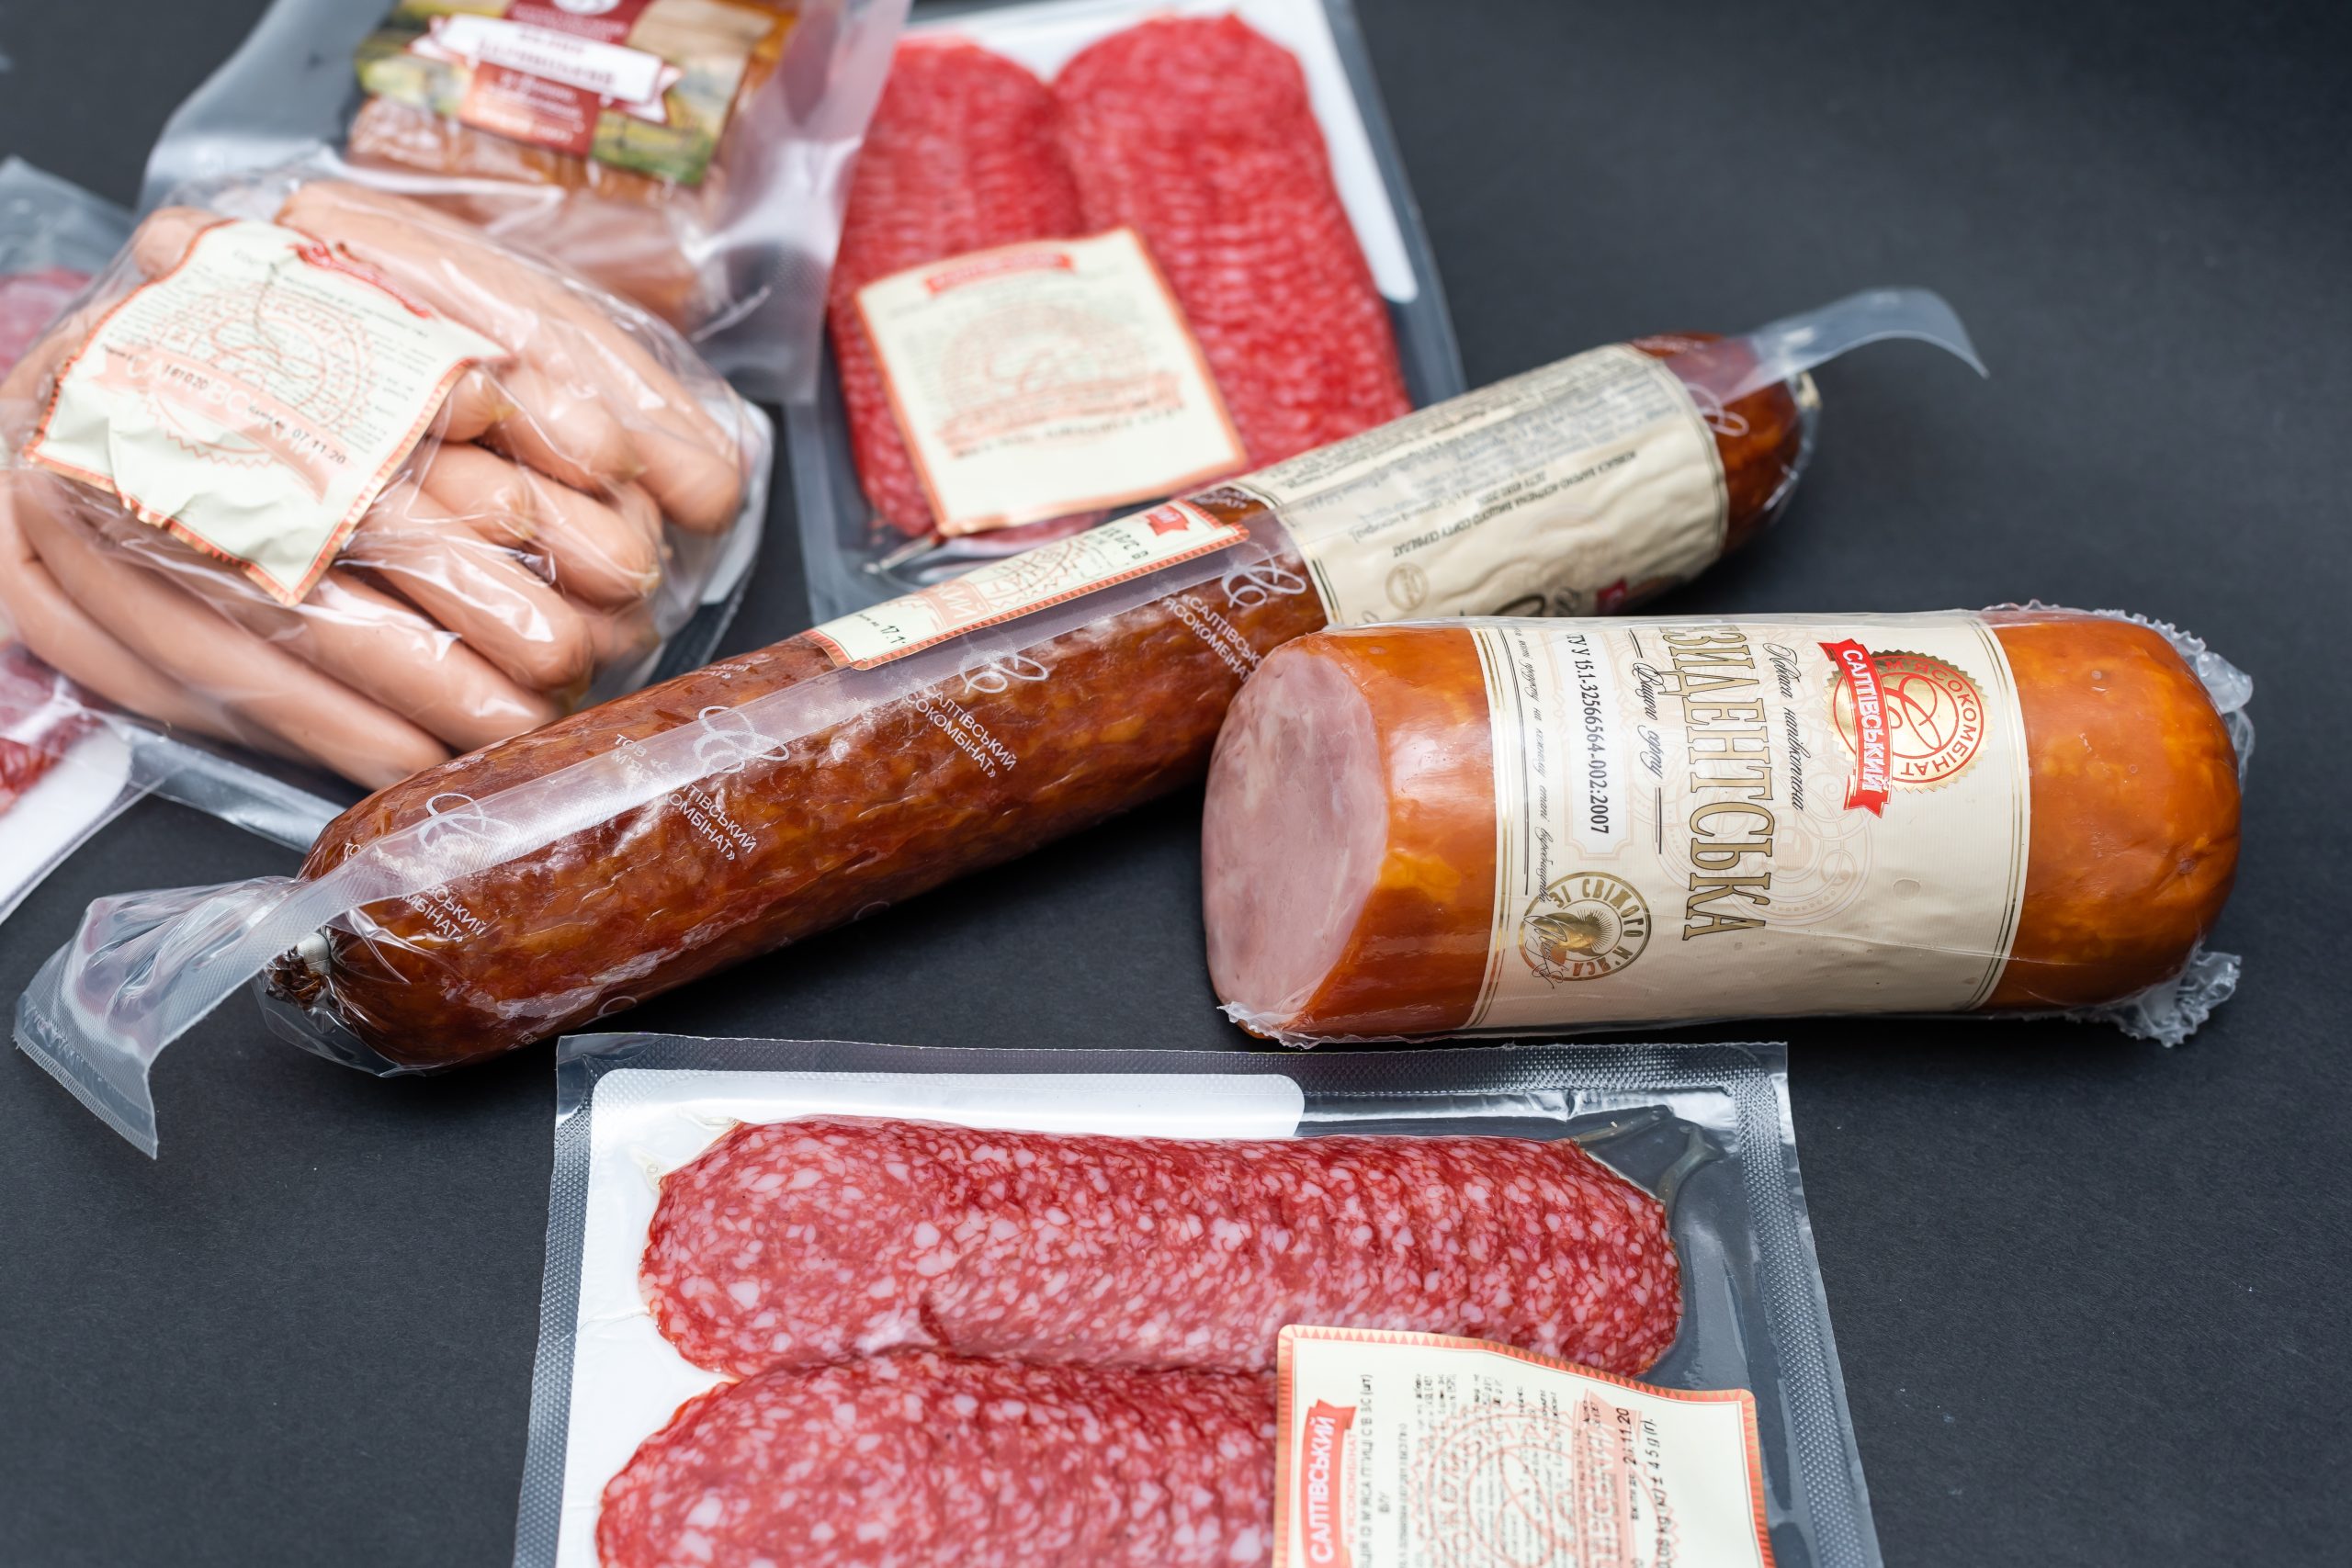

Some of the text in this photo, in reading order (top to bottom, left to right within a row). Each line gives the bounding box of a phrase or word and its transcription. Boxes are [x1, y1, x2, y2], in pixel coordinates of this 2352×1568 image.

[1571, 649, 1590, 657] У
[1533, 706, 1543, 721] на
[1574, 659, 1610, 834] 15.1-32566564-002:2007
[1632, 662, 1667, 780] Вищого сорту
[1762, 642, 1811, 812] Ковбаса напівкопчена
[1842, 649, 1889, 794] САЛТІВСЬКИЙ
[1884, 659, 1977, 777] М'ЯСОКОМБІНАТ
[1534, 828, 1554, 904] виробництва
[1581, 878, 1645, 938] СВІЖОГО
[1308, 1416, 1336, 1563] САЛТІВСЬКИЙ
